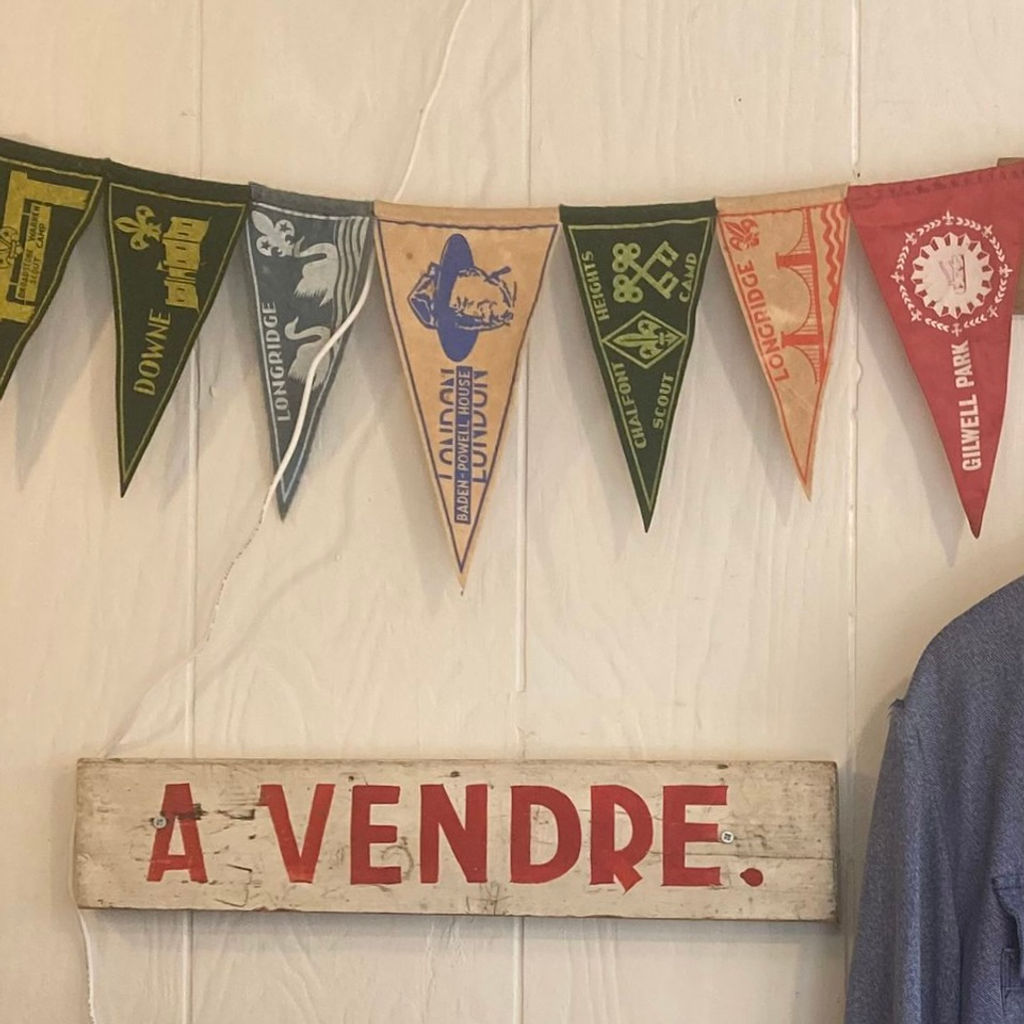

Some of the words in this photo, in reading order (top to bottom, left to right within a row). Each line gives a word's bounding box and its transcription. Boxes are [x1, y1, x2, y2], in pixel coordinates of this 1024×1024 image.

[35, 222, 47, 249] CAMP
[581, 250, 610, 321] HEIGHTS
[736, 259, 790, 382] LONGRIDGE
[132, 308, 171, 396] DOWNE
[261, 301, 292, 422] LONGRIDGE
[653, 372, 675, 430] SCOUT
[678, 252, 698, 303] CAMP
[951, 340, 975, 389] PARK
[457, 370, 472, 416] HOUSE
[611, 361, 648, 450] CHALFONT
[958, 394, 982, 471] GILWELL
[146, 783, 209, 883] A
[257, 783, 764, 894] VENDRE.
